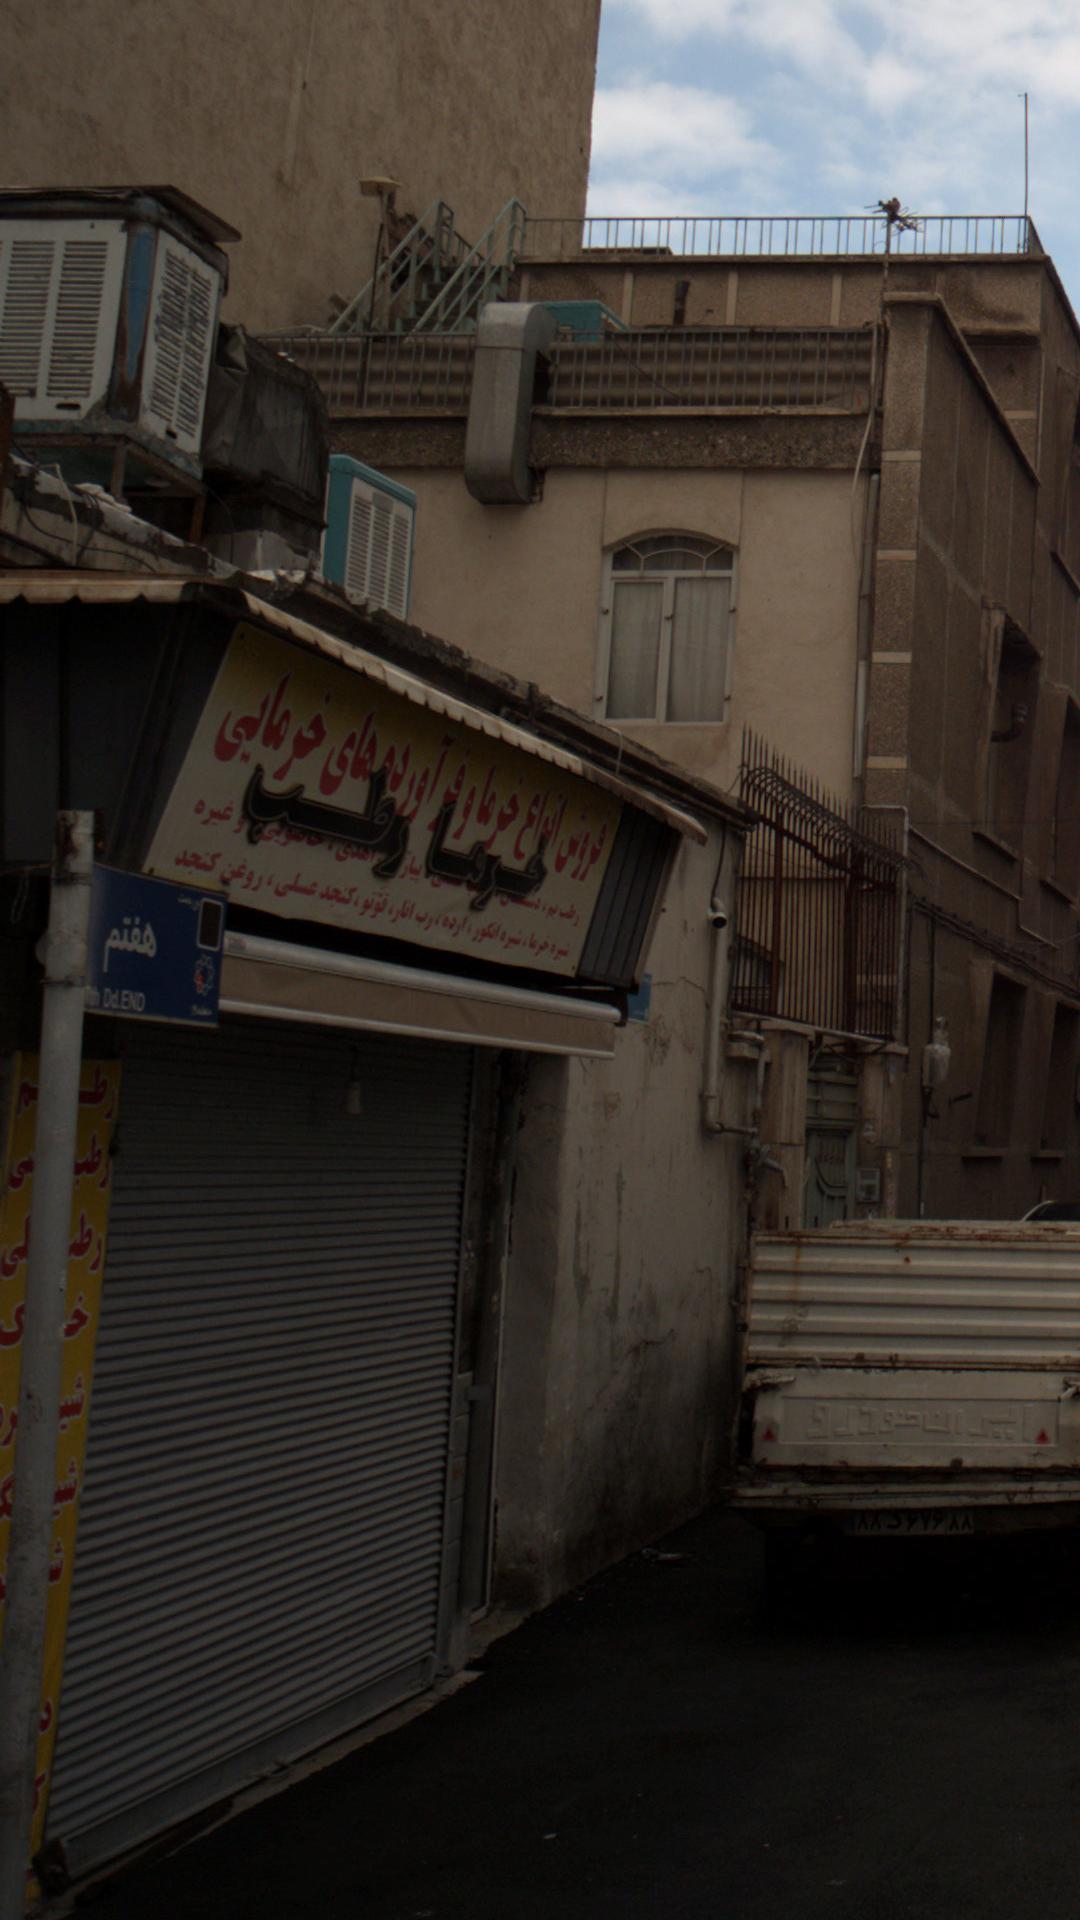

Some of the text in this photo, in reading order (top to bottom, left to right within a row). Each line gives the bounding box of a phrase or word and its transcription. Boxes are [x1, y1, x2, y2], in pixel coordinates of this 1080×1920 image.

[214, 672, 332, 781] خرمایی
[194, 799, 234, 826] غیره
[242, 763, 547, 912] خرما رطب
[453, 786, 476, 840] و
[476, 766, 523, 850] خرما
[513, 791, 568, 860] انواع
[175, 849, 222, 875] کنجد
[220, 859, 263, 892] روغن
[555, 808, 608, 881] فروش
[102, 916, 157, 976] هفتم
